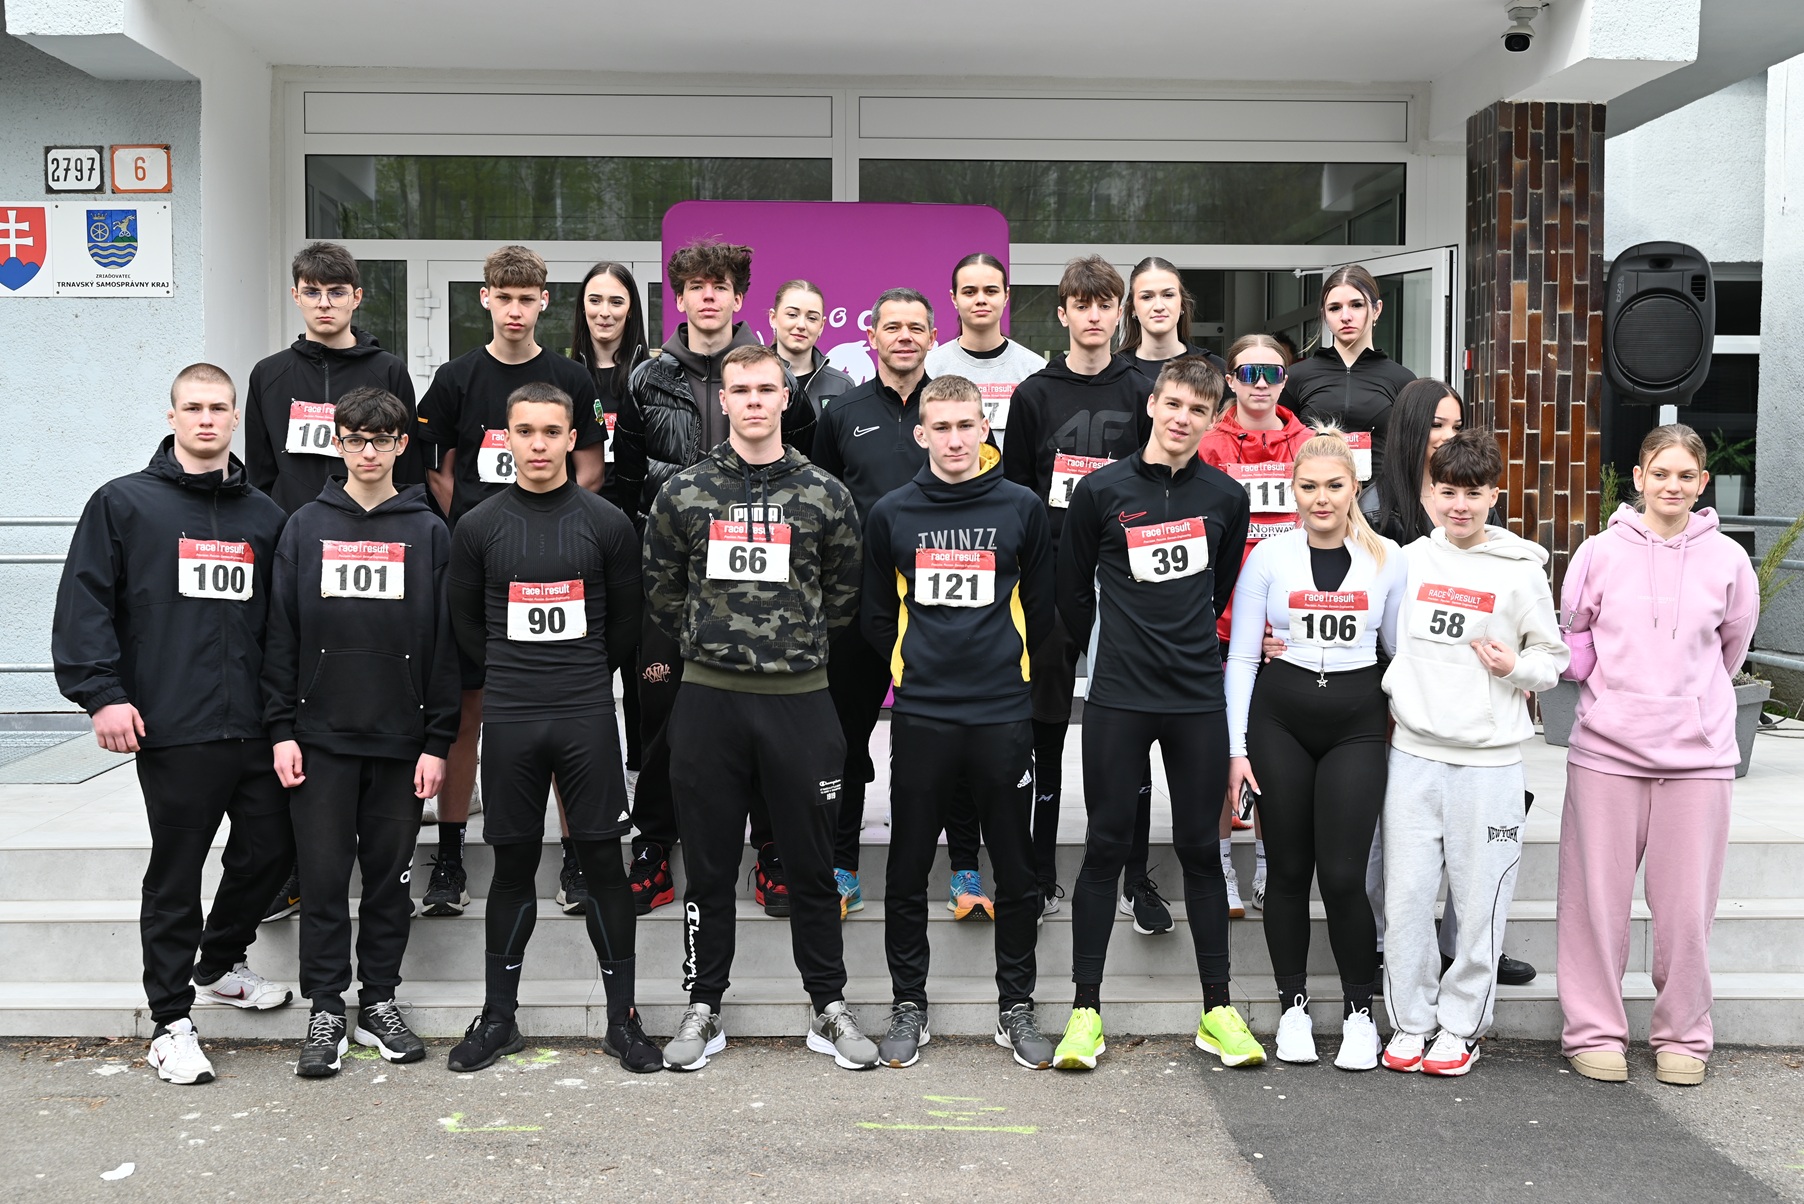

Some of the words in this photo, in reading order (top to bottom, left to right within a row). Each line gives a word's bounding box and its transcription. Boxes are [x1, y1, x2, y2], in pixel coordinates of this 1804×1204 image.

[51, 157, 96, 182] 2797
[134, 156, 147, 181] 6
[57, 279, 94, 288] TRNAVSKÝ
[96, 279, 149, 288] SAMOSPRÁVNY
[991, 384, 1013, 393] result
[304, 405, 322, 413] race
[298, 422, 336, 449] 10
[495, 451, 517, 478] 8
[1067, 459, 1085, 468] race
[1240, 464, 1259, 473] race
[1263, 462, 1286, 472] result
[724, 525, 744, 534] race
[917, 527, 998, 550] TWINZZ
[1141, 528, 1162, 539] race
[1166, 521, 1191, 535] result
[195, 543, 216, 552] race
[220, 543, 245, 555] result
[338, 544, 359, 553] race
[362, 543, 389, 554] result
[930, 552, 950, 561] race
[954, 552, 981, 563] result
[728, 545, 768, 575] 66
[1151, 544, 1189, 576] 39
[193, 563, 246, 594] 100
[335, 563, 388, 592] 101
[927, 572, 979, 601] 121
[521, 586, 541, 596] race
[544, 583, 570, 596] result
[1304, 593, 1324, 602] race
[1329, 593, 1355, 603] result
[1428, 589, 1447, 599] RACE
[1454, 593, 1482, 605] RESULT
[527, 606, 566, 635] 90
[1301, 613, 1357, 642] 106
[1429, 608, 1466, 639] 58
